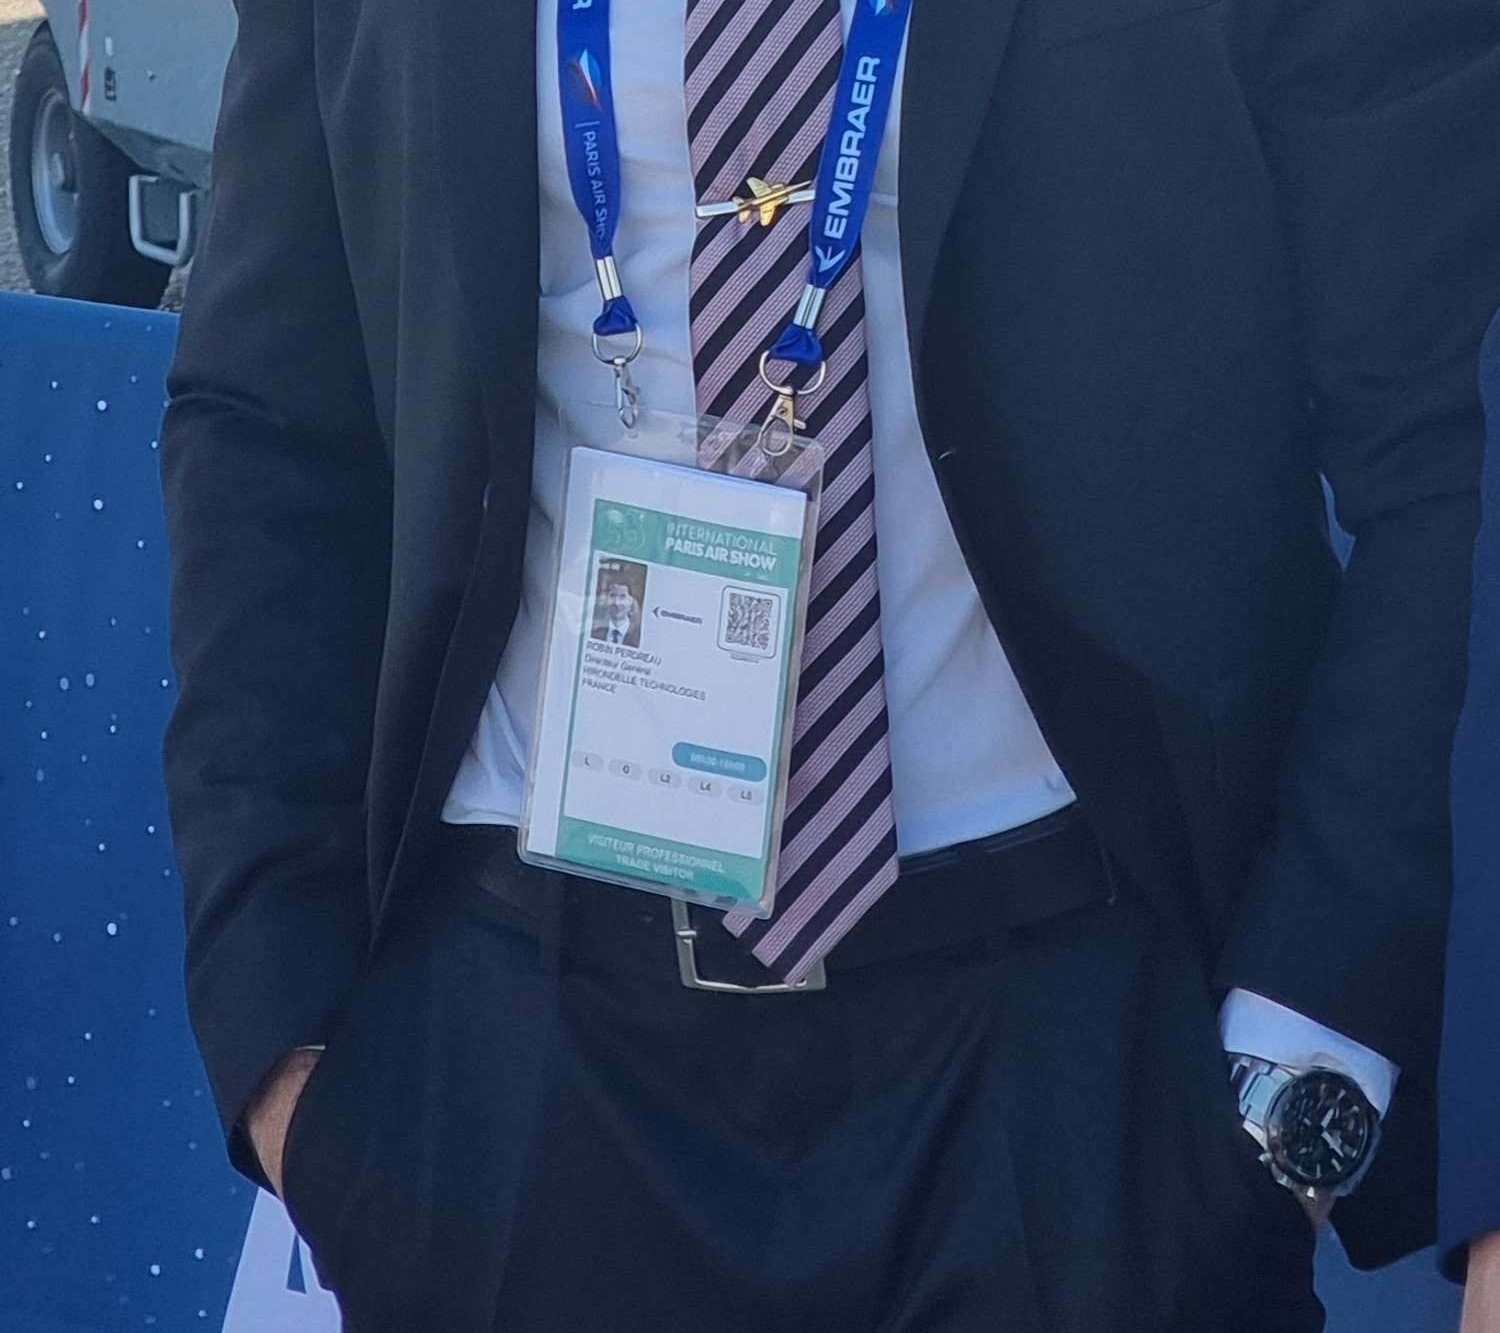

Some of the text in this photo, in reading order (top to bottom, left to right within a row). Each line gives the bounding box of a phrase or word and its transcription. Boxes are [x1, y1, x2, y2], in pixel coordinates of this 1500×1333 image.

[823, 55, 881, 240] EMBRAER
[584, 130, 608, 239] PARIS AIR SHO
[665, 536, 777, 572] PARIS AIR SHOW
[667, 522, 777, 556] INTERNATIONAL
